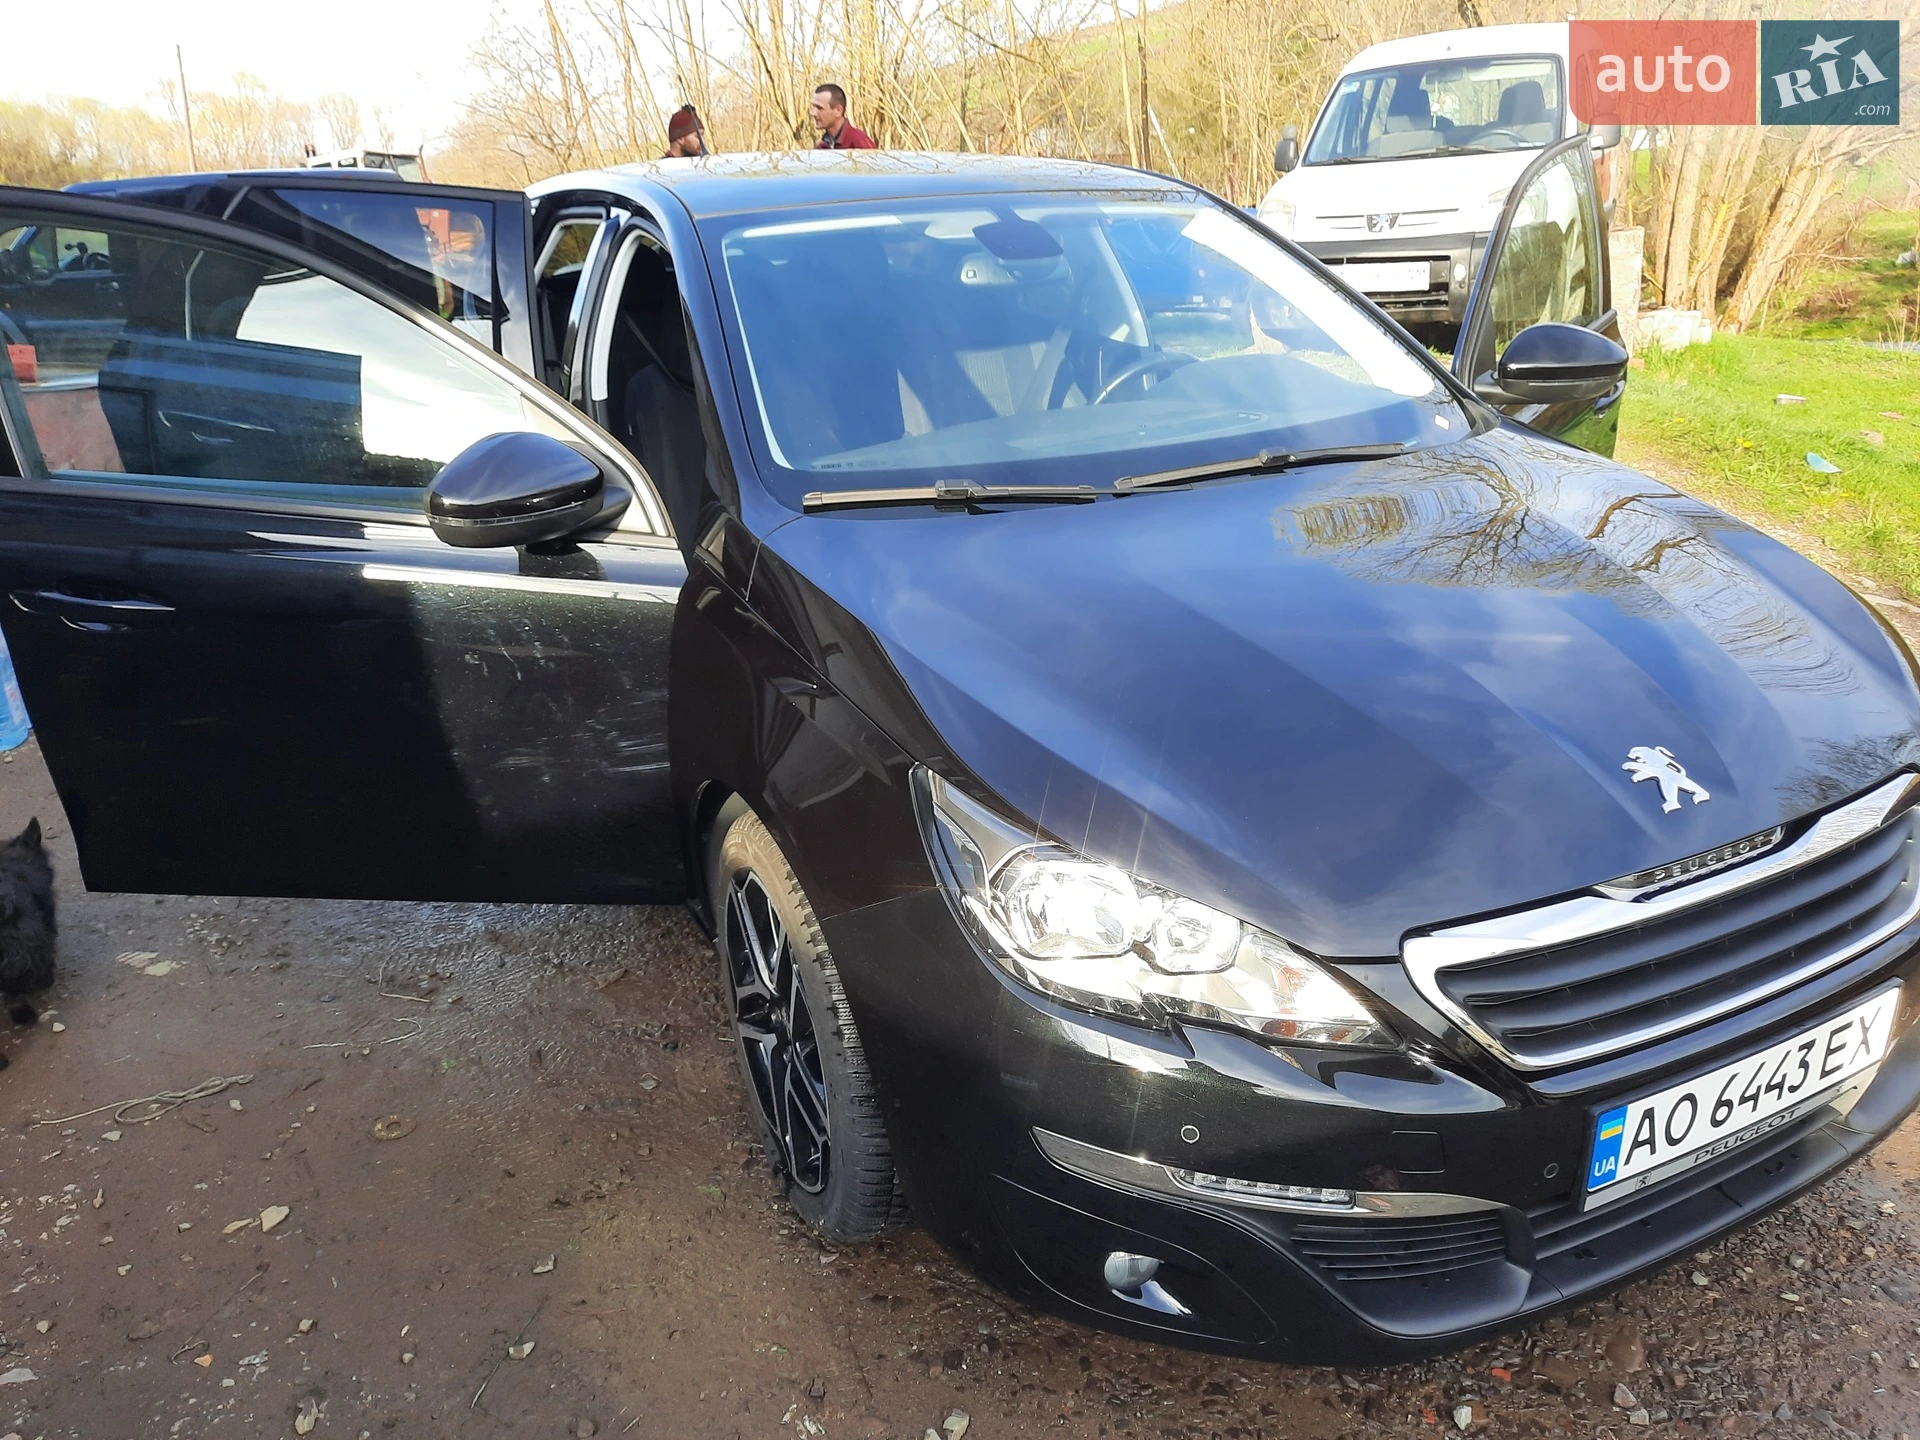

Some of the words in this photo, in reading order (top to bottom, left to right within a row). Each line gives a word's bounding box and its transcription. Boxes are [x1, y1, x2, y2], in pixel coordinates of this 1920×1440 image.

[1653, 835, 1765, 883] PEUGEOT
[1623, 1092, 1698, 1166] AO
[1709, 1038, 1816, 1128] 6443
[1819, 1006, 1881, 1080] EX
[1693, 1106, 1801, 1164] PEUGEOT
[1594, 1154, 1616, 1177] UA
